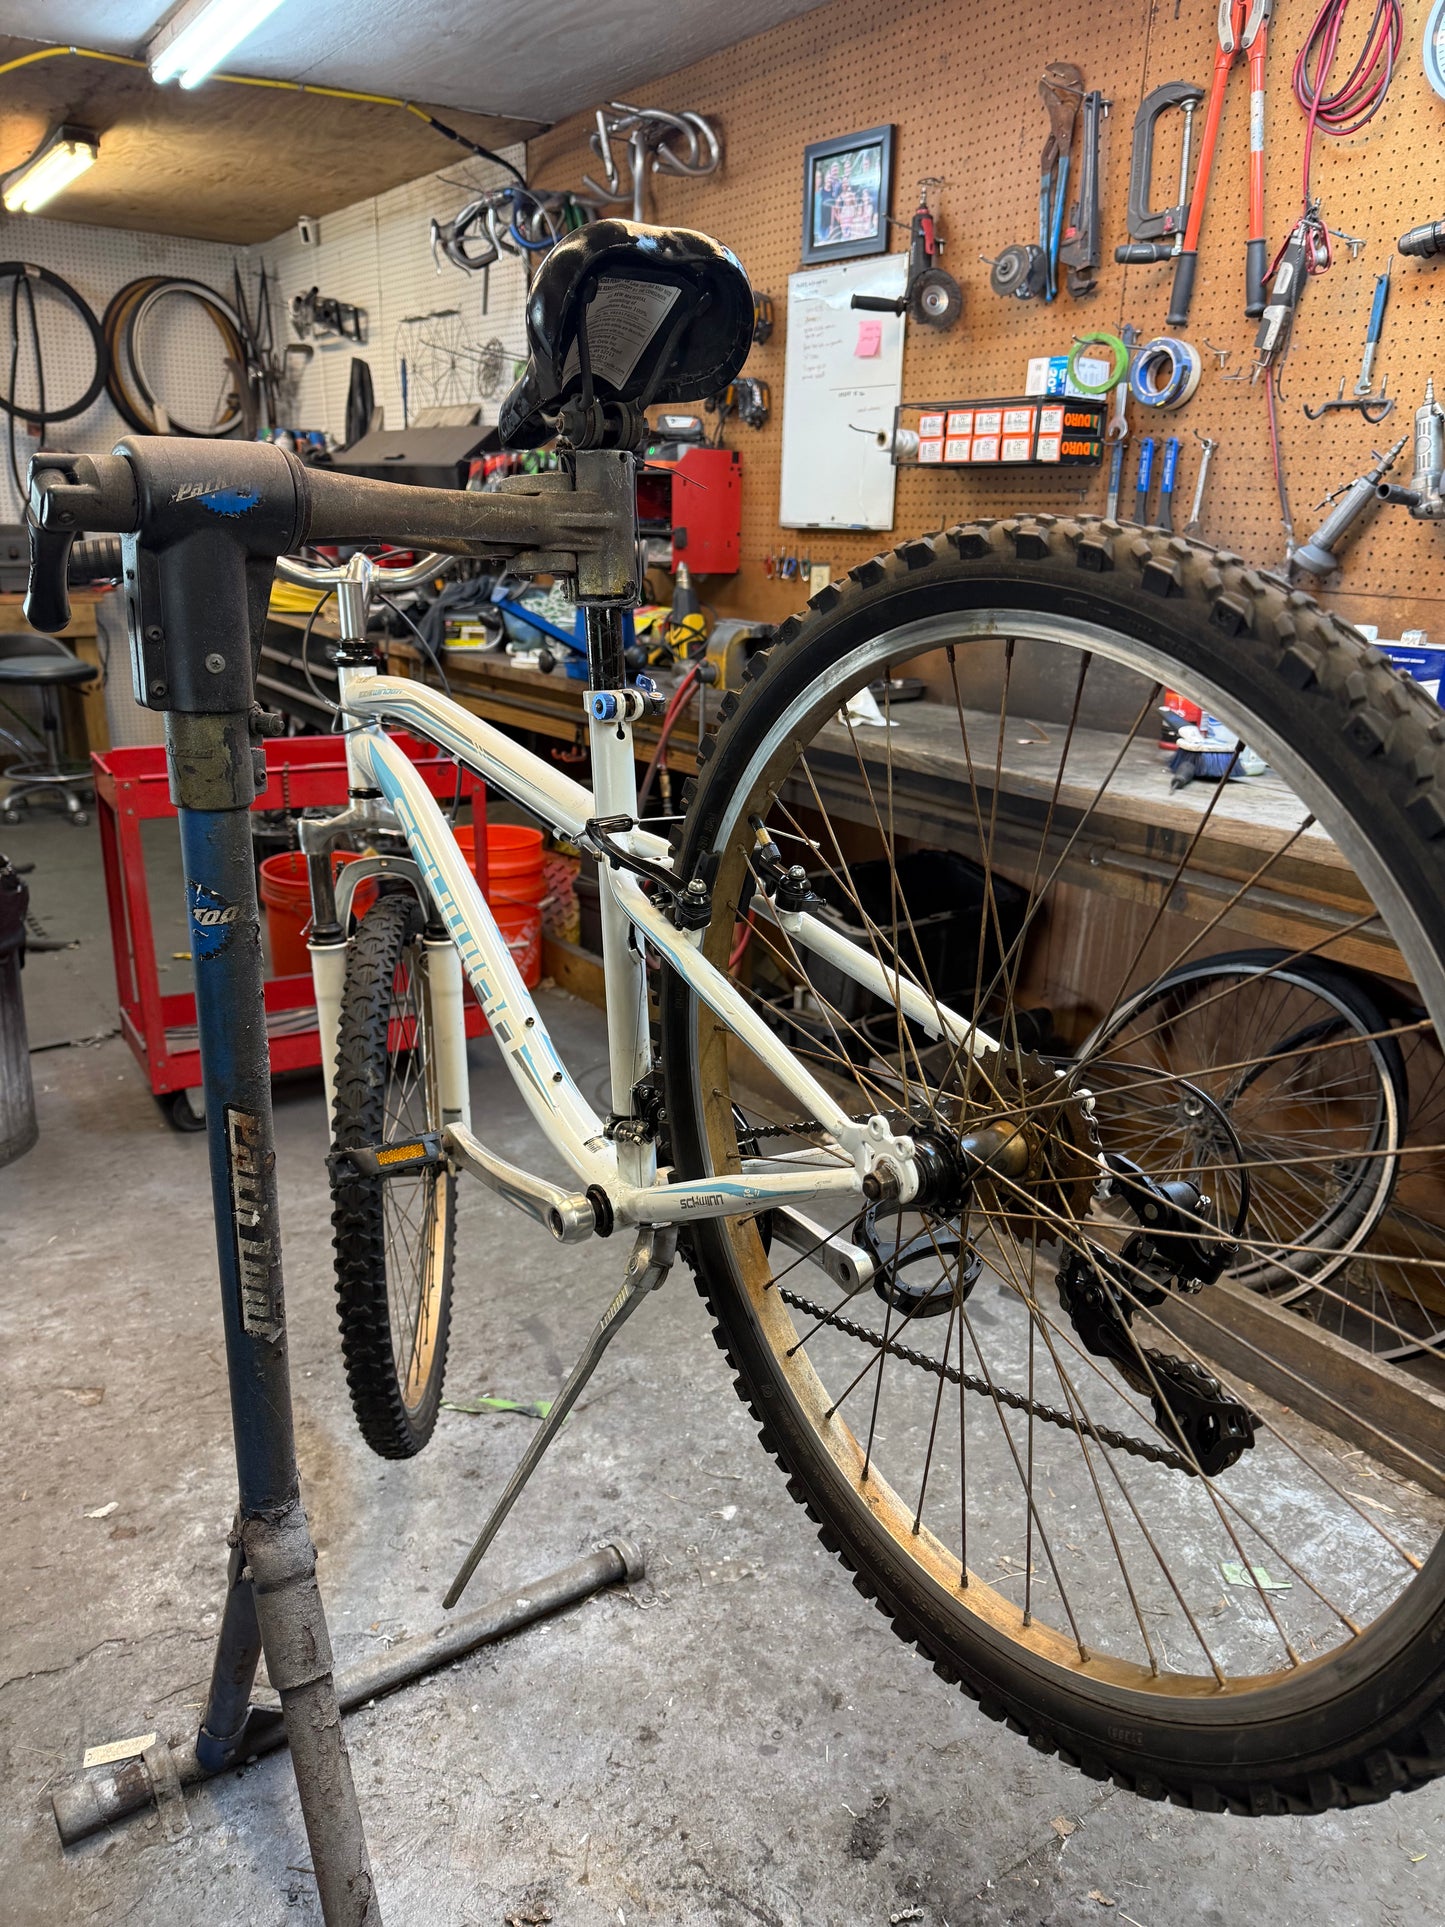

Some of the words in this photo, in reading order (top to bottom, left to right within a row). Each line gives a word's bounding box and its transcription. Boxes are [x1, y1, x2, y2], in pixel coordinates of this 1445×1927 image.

[1064, 413, 1091, 428] DURO
[1061, 441, 1090, 456] DURO
[193, 905, 241, 926] Too
